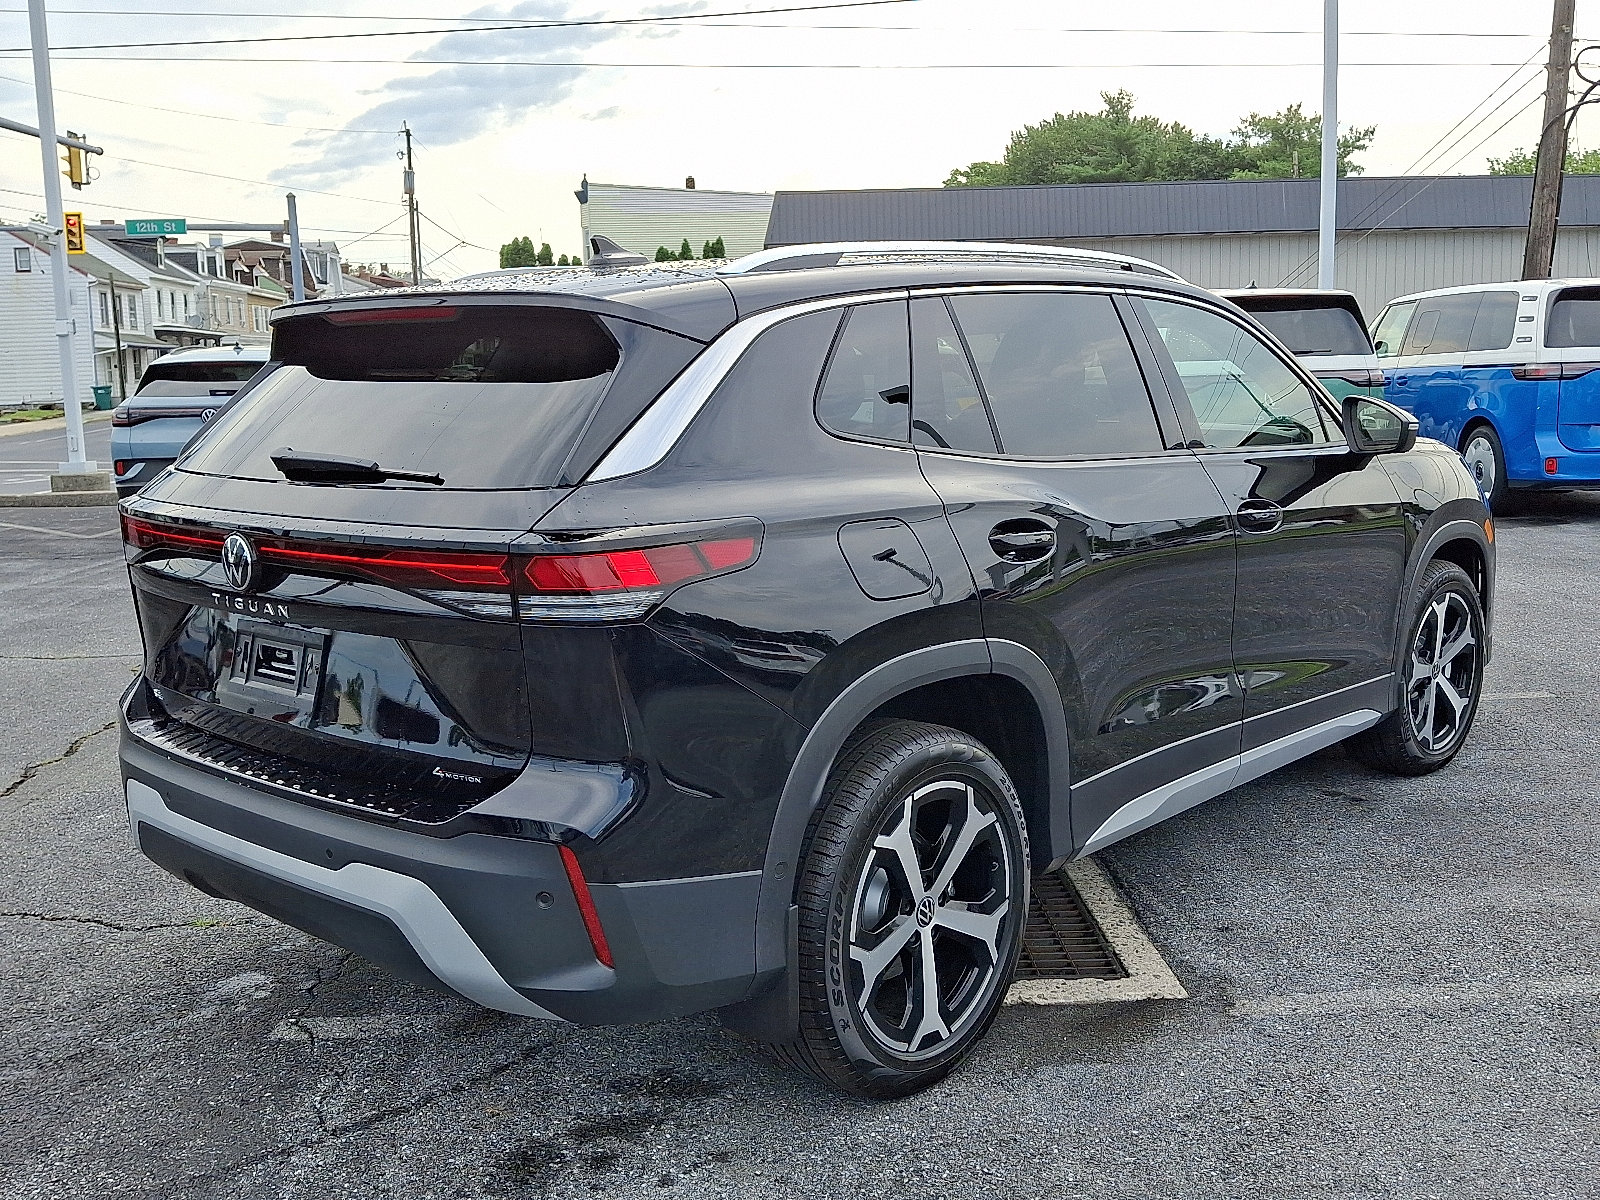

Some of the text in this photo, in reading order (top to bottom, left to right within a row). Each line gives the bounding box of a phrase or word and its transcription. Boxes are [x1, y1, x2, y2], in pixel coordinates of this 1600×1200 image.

[136, 221, 176, 232] 12th St
[222, 534, 252, 591] VW
[212, 592, 290, 619] TIGUAN
